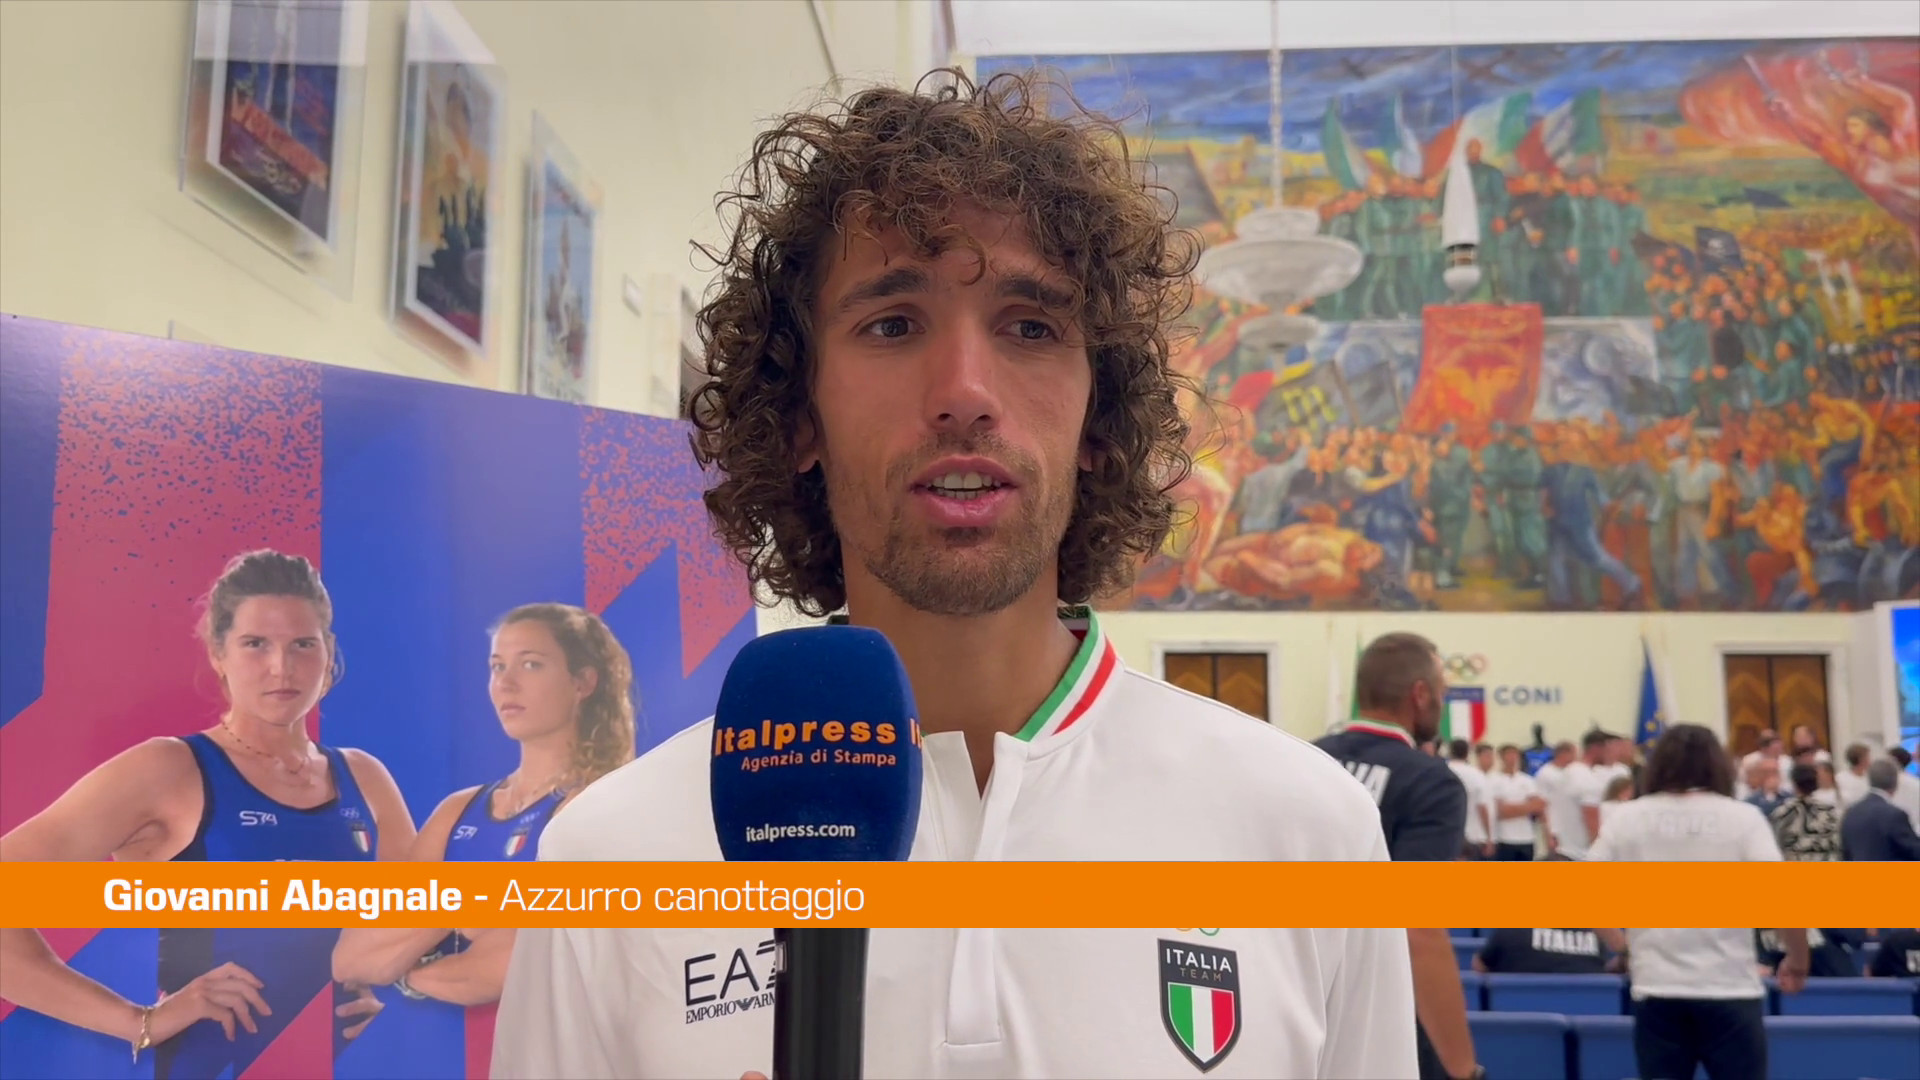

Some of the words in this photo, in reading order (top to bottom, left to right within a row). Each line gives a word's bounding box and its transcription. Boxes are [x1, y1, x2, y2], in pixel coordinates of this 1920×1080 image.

[1494, 686, 1562, 706] CONI
[715, 720, 897, 756] Italpress
[741, 750, 803, 772] Agenzia
[810, 749, 827, 764] di
[834, 749, 896, 767] Stampa
[746, 823, 856, 842] italpress.com
[1531, 928, 1599, 957] ITALIA
[1166, 948, 1232, 973] ITALIA
[1180, 967, 1222, 982] TEAM
[685, 1000, 737, 1025] EMPORIO
